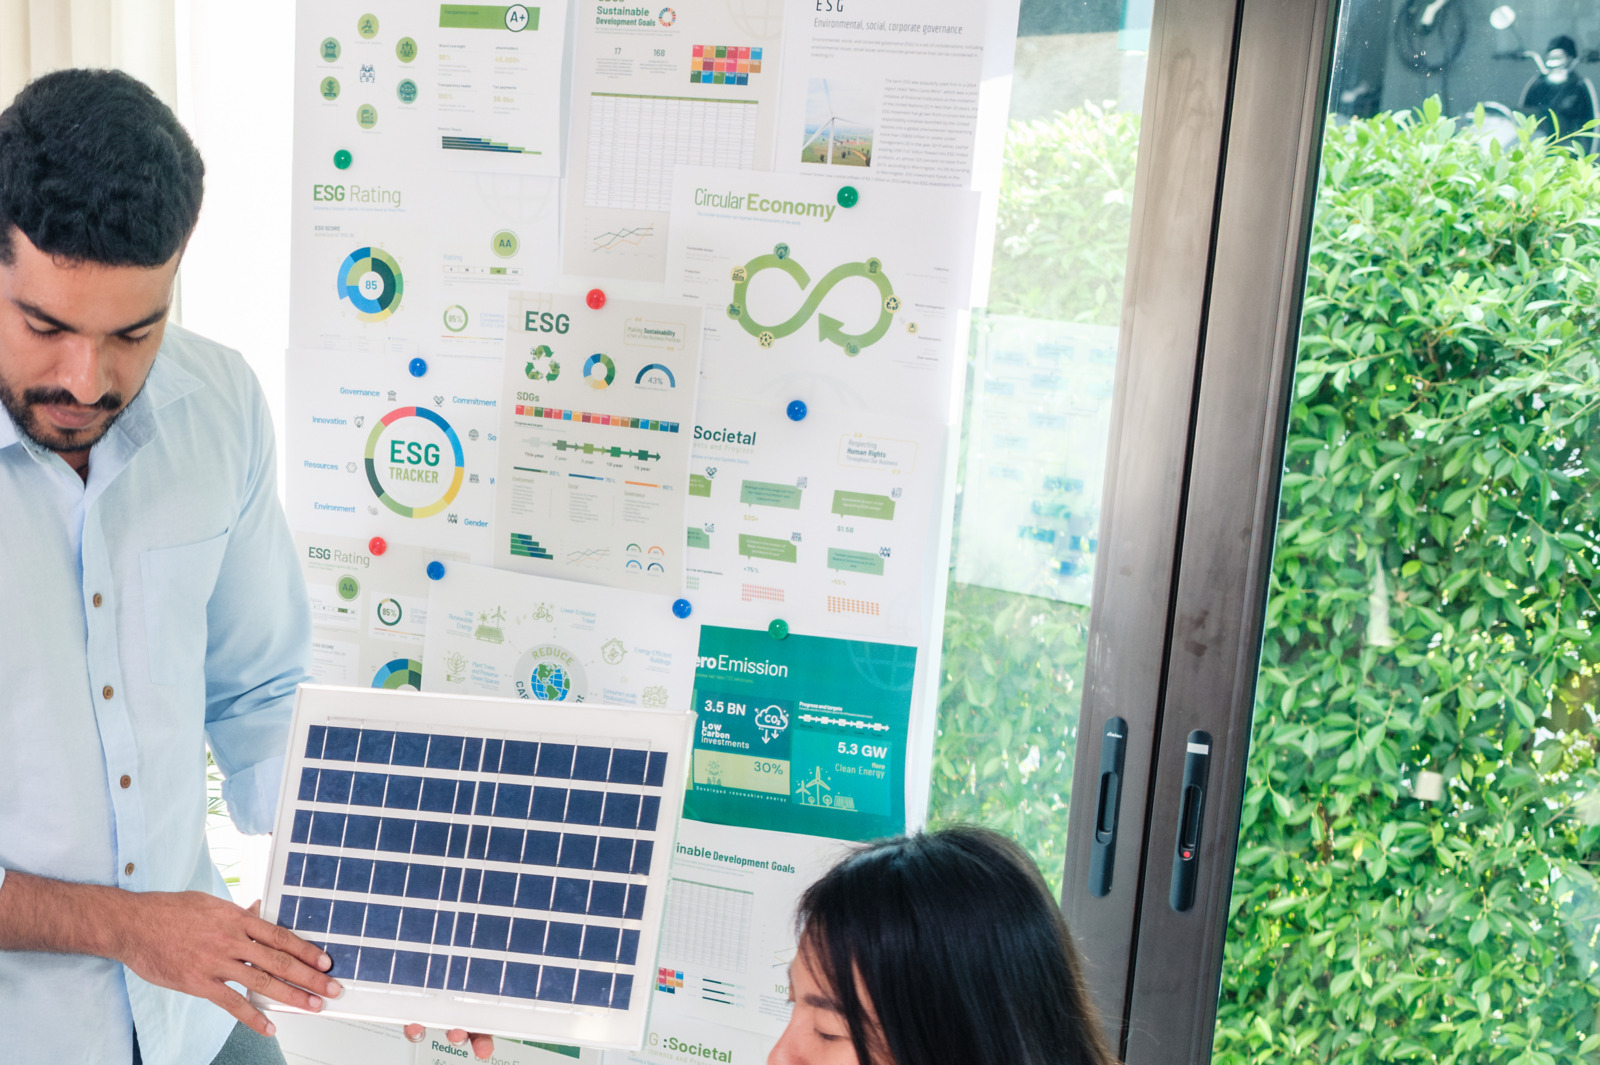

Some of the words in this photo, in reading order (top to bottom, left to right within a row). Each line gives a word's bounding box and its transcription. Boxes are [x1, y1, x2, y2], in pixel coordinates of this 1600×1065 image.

[510, 11, 525, 23] A+
[597, 5, 650, 17] Sustainable
[595, 17, 637, 27] Development
[638, 18, 656, 27] Goals
[814, 17, 865, 31] Environmental,
[865, 20, 887, 31] social,
[888, 22, 921, 33] corporate
[922, 24, 963, 35] governance
[614, 47, 622, 55] 17
[653, 49, 666, 57] 168
[313, 184, 345, 202] ESG
[350, 184, 401, 208] Rating
[694, 188, 745, 210] Circular
[746, 192, 836, 223] Economy
[499, 238, 512, 249] AA
[365, 280, 378, 291] 85
[448, 314, 463, 324] 85%
[524, 310, 570, 335] ESG
[643, 327, 675, 338] Sustainability
[648, 377, 663, 385] 43%
[339, 386, 380, 397] Governance
[452, 396, 497, 407] Commitment
[516, 391, 540, 402] SDGs
[312, 416, 347, 426] Innovation
[693, 425, 757, 446] Societal
[390, 439, 440, 467] ESG
[847, 447, 867, 456] Human
[868, 449, 887, 458] Rights
[303, 460, 339, 471] Resources
[389, 466, 439, 484] TRACKER
[314, 502, 356, 513] Environment
[464, 518, 489, 528] Gender
[308, 546, 331, 560] ESG
[333, 549, 370, 568] Rating
[342, 583, 354, 593] AA
[382, 608, 397, 617] 85%
[531, 646, 575, 667] REDUCE
[696, 656, 717, 670] ero
[718, 654, 788, 678] Emission
[704, 699, 724, 713] 3.5
[727, 702, 746, 716] BN
[702, 720, 722, 731] Low
[701, 729, 730, 740] Carbon
[837, 741, 858, 755] 5.3
[861, 745, 888, 760] GW
[754, 761, 784, 775] 30%
[834, 763, 856, 774] Clean
[858, 766, 886, 780] Energy
[676, 842, 712, 860] inable
[713, 851, 770, 870] Development
[771, 858, 796, 874] Goals
[431, 1040, 469, 1059] Reduce
